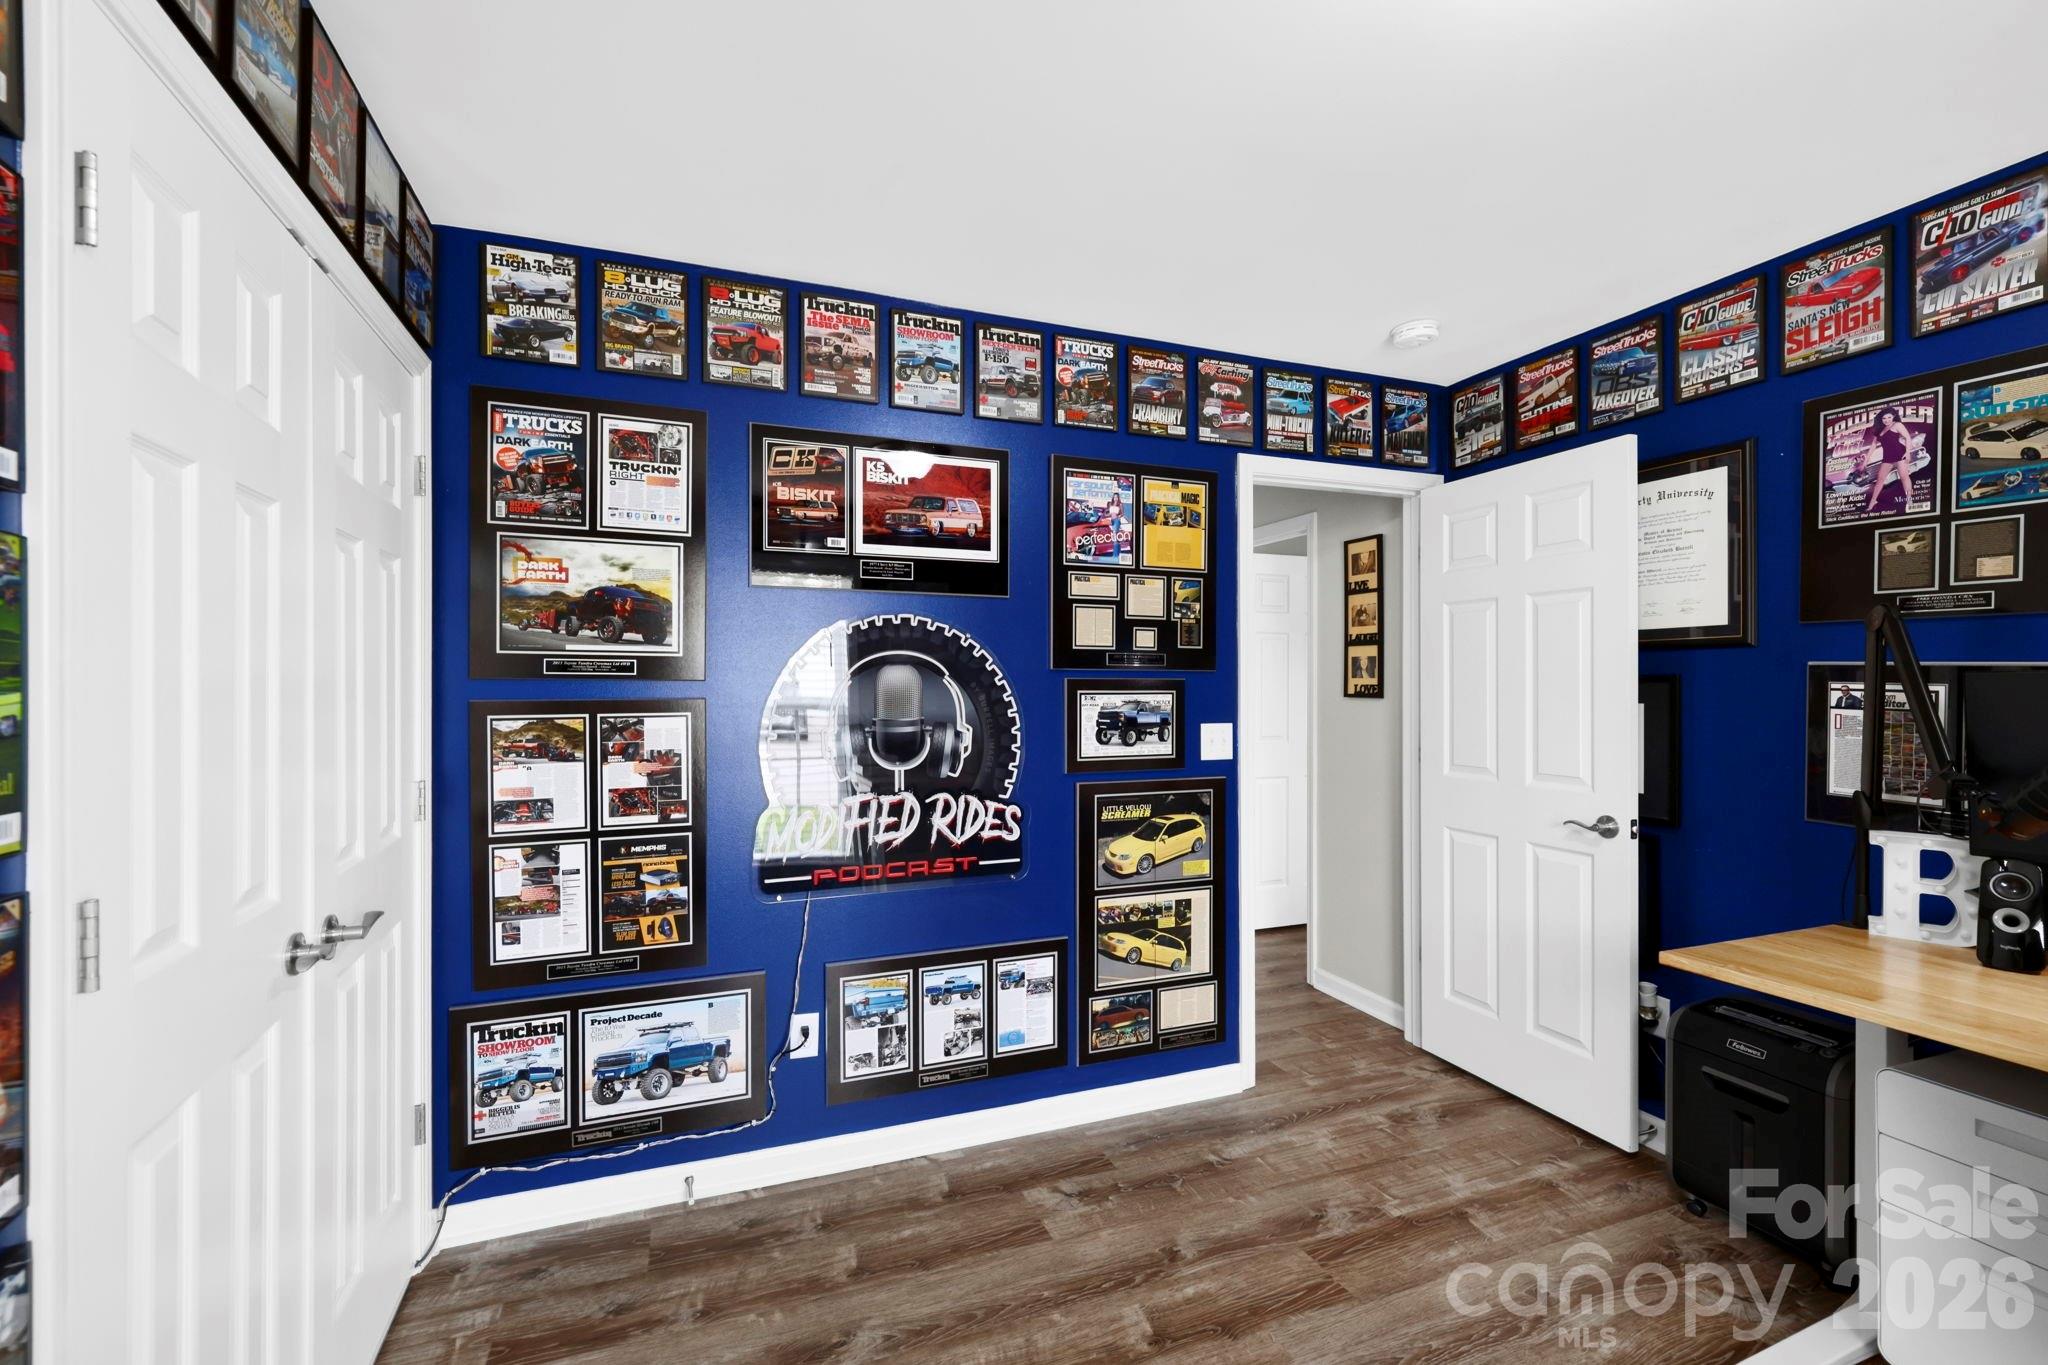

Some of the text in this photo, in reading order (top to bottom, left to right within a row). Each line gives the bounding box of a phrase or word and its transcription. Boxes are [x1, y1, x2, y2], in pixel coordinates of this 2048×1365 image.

[1921, 209, 1949, 224] SERGEANT
[1949, 201, 1970, 213] SQUARE
[1971, 195, 1986, 205] GOES
[1990, 187, 2006, 198] SEMA
[1979, 198, 2034, 229] GUIDE
[1827, 235, 1882, 259] BUYER'S GUIDE INSIDE
[604, 270, 625, 284] 8
[630, 273, 682, 293] LUG
[1960, 258, 2038, 302] SLAYER
[604, 283, 681, 299] HD TRUCK
[734, 290, 781, 307] LUG
[663, 299, 681, 307] RAM
[709, 298, 780, 314] HD TRUCK
[807, 297, 875, 321] Truckin
[1718, 298, 1752, 320] GUIDE
[509, 304, 562, 320] BREAKING
[710, 306, 742, 316] FEATURE
[743, 311, 781, 322] BLOWOUT!
[810, 311, 870, 328] The SEMA
[1788, 300, 1851, 331] SANTA'S NEW
[807, 318, 840, 330] Issue
[896, 312, 960, 336] Truckin
[1786, 296, 1881, 356] SLEIGH
[896, 327, 955, 341] SHOWROOM
[982, 329, 1040, 349] Truckin
[1062, 339, 1113, 359] TRUCKS
[984, 353, 1009, 364] F-150
[1057, 358, 1108, 372] DARK EARTH
[1680, 339, 1756, 376] CLASSIC
[1680, 361, 1744, 388] CRUISERS
[1592, 384, 1656, 411] TAKEOVER
[1521, 395, 1573, 421] CUTTING
[503, 414, 583, 434] TRUCKS
[496, 435, 573, 451] DARK EARTH
[608, 461, 682, 476] TRUCKIN'
[866, 461, 885, 473] K5
[609, 471, 644, 480] RIGHT
[866, 471, 910, 485] BISKIT
[777, 487, 836, 502] BISKIT
[1181, 492, 1200, 505] MAGIC
[1657, 487, 1715, 503] University
[1849, 494, 1866, 502] Kids!
[1075, 531, 1131, 549] perfection
[517, 560, 559, 572] DARK
[517, 571, 566, 581] EARTH
[1348, 580, 1369, 590] LIVE
[1354, 684, 1378, 694] LOVE
[1884, 700, 1907, 708] ditor
[1101, 809, 1151, 820] SCREAMER
[1125, 803, 1152, 812] YELLOW
[764, 792, 1022, 864] MODIFIED RIDES
[631, 844, 667, 853] MEMPHIS
[811, 857, 977, 885] PODCAST
[1868, 830, 1987, 948] B
[590, 1011, 663, 1026] Project Decade
[474, 1021, 564, 1044] Truckin
[477, 1035, 556, 1054] SHOWROOM
[1732, 1041, 1761, 1056] Fellowes
[488, 1050, 510, 1058] SHOW
